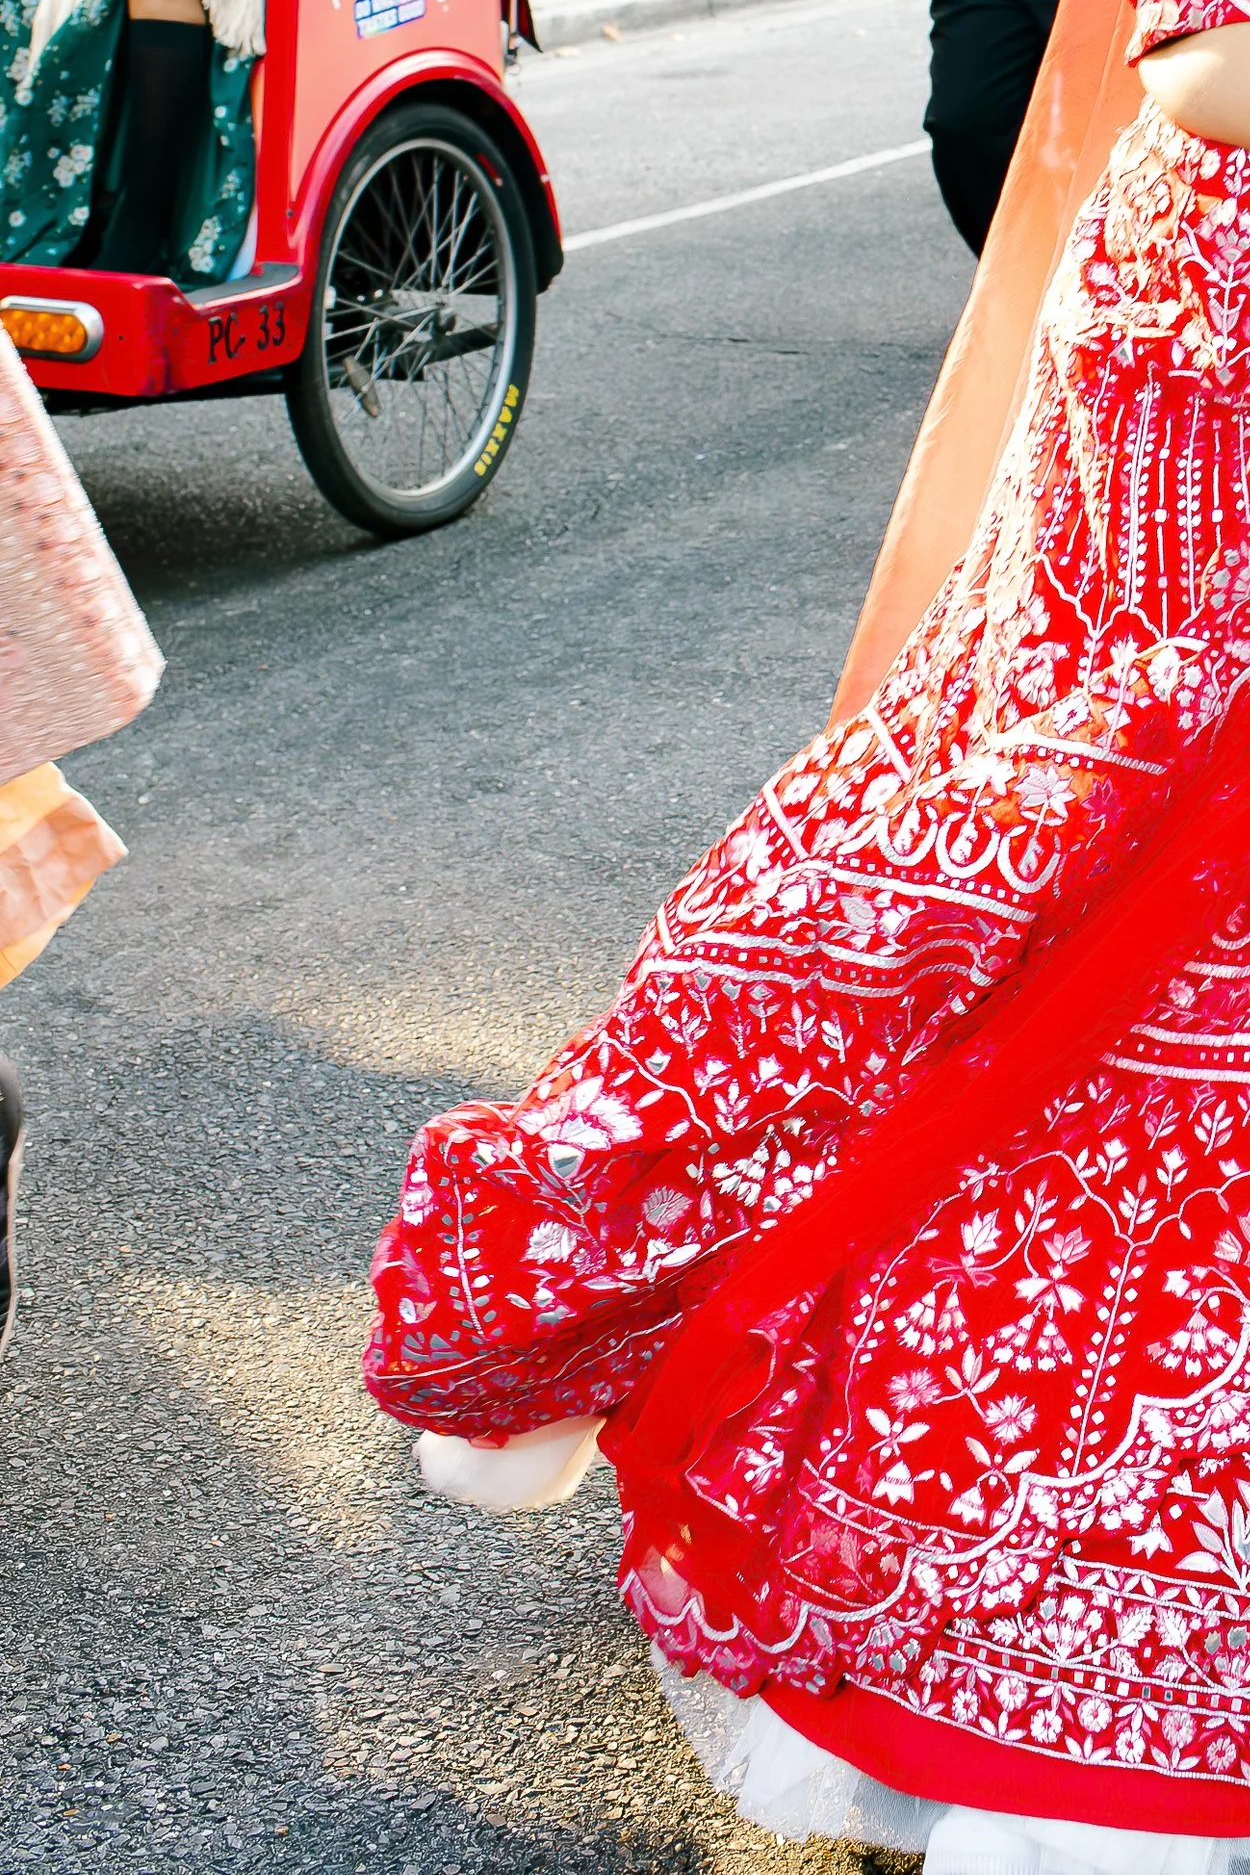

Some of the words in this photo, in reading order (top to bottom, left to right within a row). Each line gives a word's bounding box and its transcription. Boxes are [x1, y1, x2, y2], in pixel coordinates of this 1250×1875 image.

[208, 312, 246, 365] PC
[257, 300, 286, 352] 33
[474, 384, 520, 477] MAXXIS
